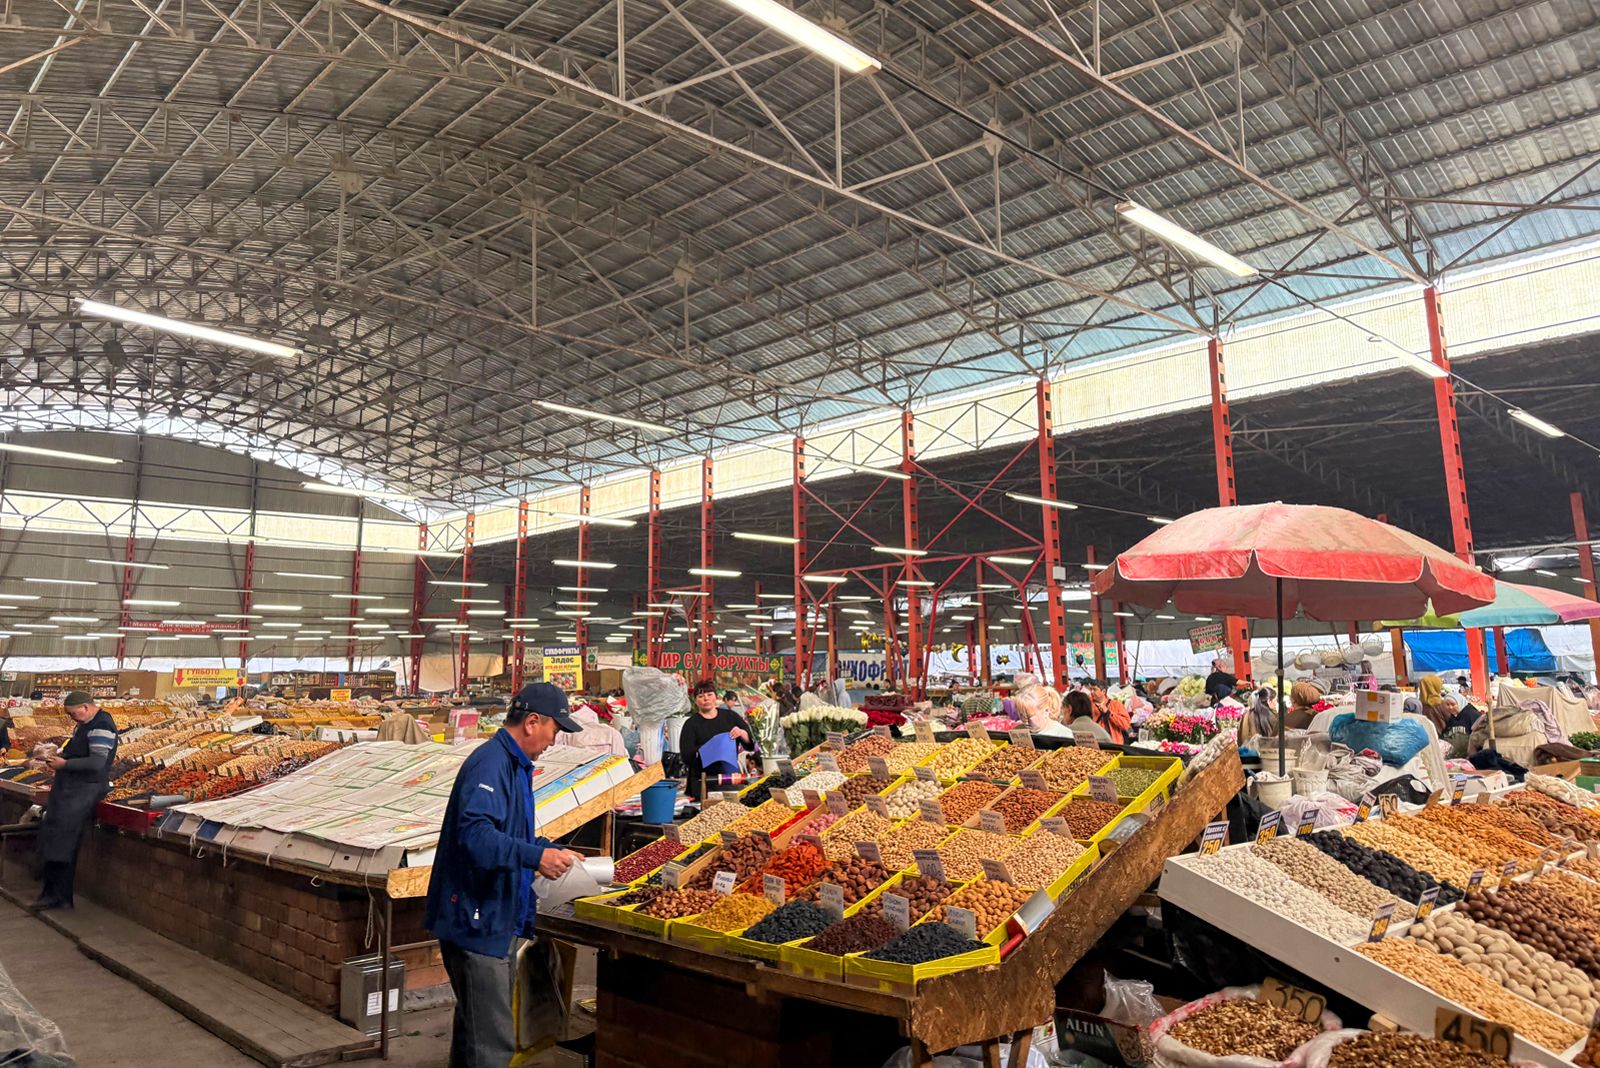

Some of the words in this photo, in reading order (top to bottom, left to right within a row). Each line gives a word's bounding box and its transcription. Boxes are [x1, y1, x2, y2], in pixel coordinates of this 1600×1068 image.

[1257, 825, 1276, 845] 350
[1201, 839, 1221, 856] 250
[1275, 986, 1324, 1023] 350
[1066, 1018, 1105, 1037] ALTIN
[1442, 1014, 1512, 1059] 450
